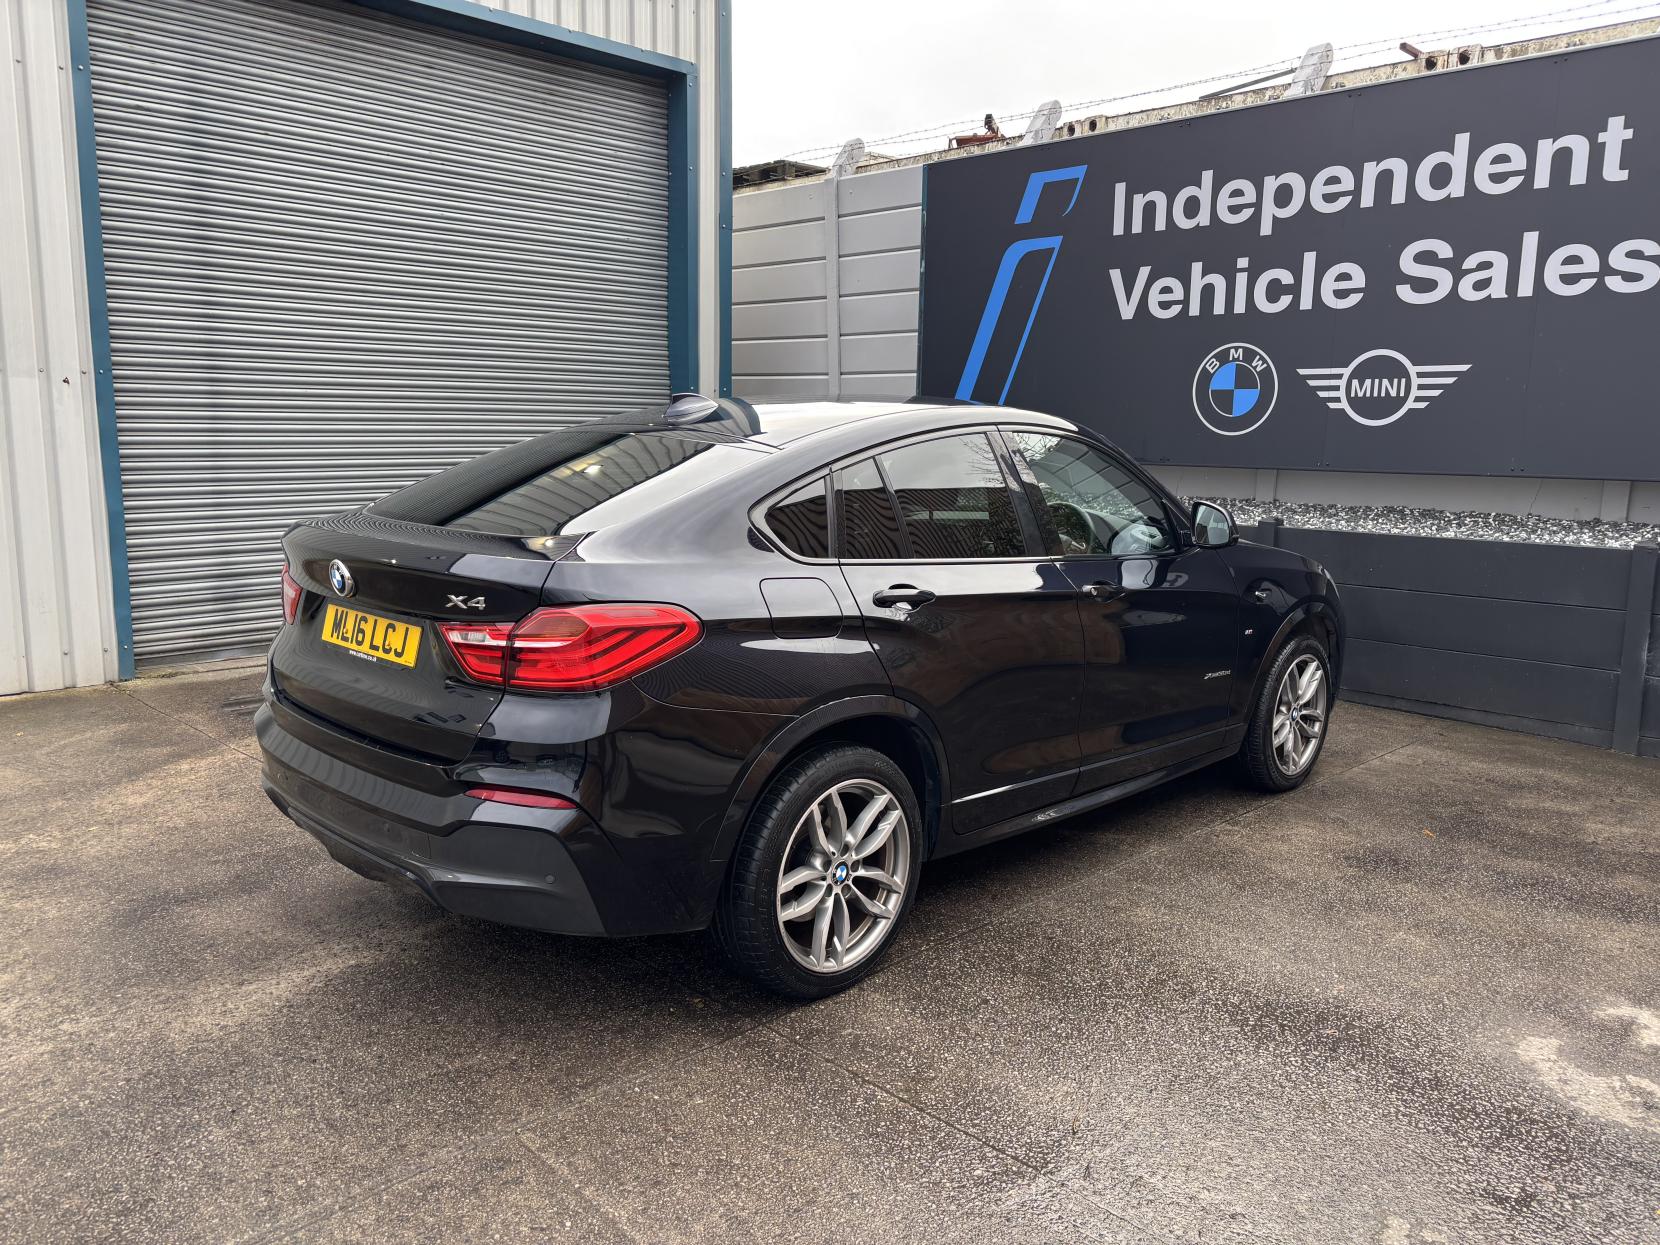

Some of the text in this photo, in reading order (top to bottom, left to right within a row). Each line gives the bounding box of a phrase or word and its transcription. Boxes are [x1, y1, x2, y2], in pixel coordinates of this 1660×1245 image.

[1112, 115, 1634, 237] Independent
[1108, 230, 1660, 320] Vehicle Sales
[1205, 348, 1268, 374] BMW
[1350, 377, 1406, 398] MINI
[445, 594, 486, 610] X4
[330, 608, 410, 659] ML16 LCJ
